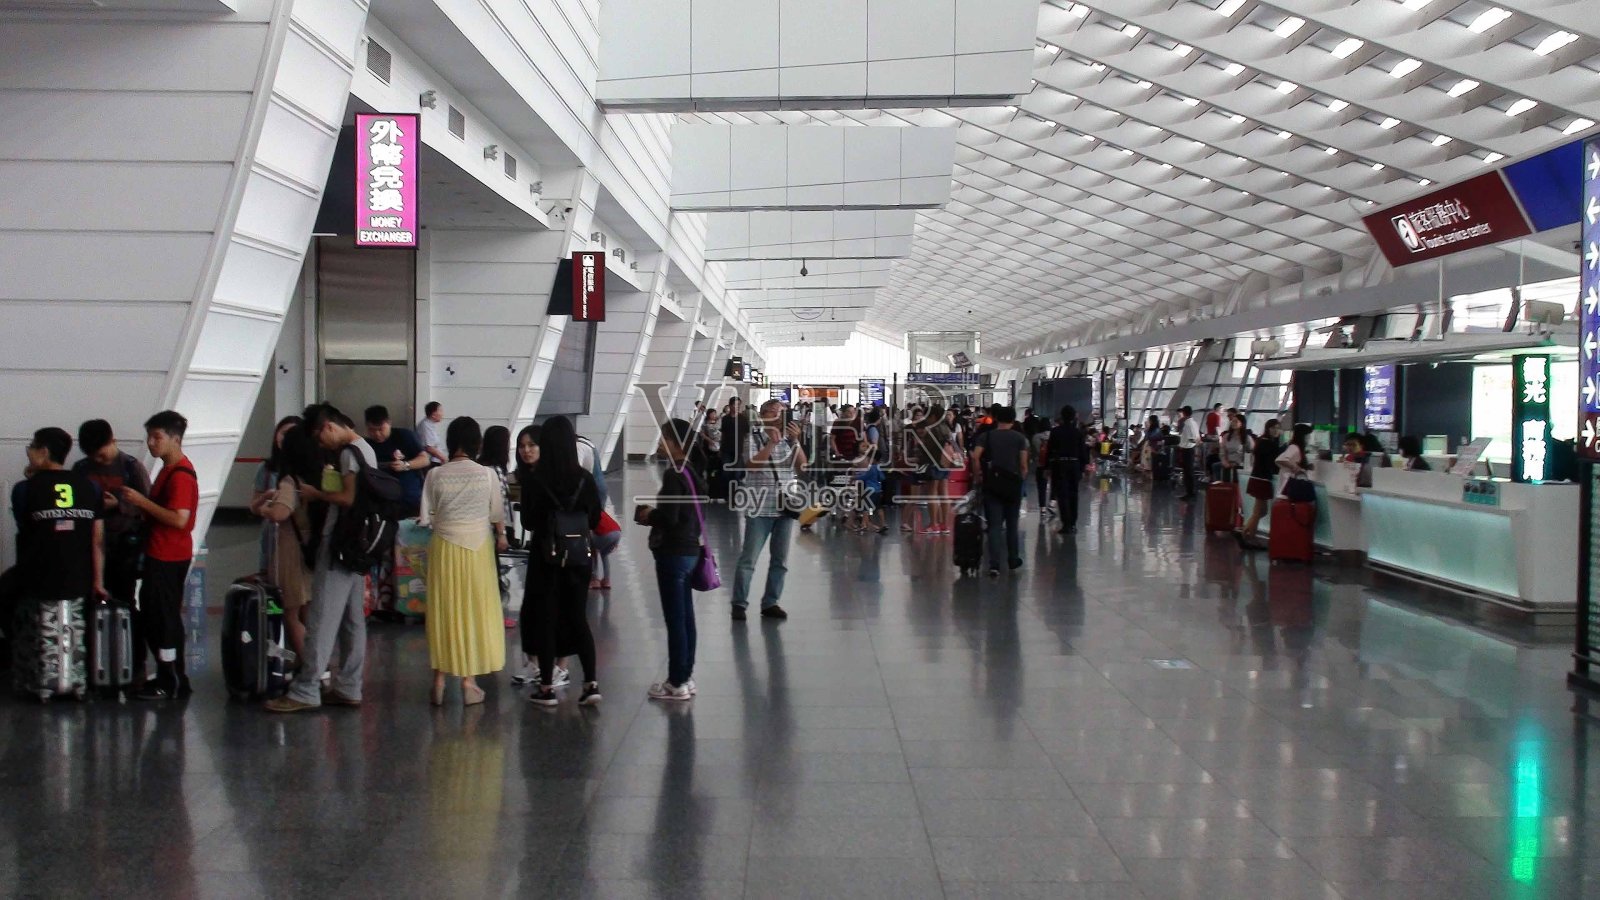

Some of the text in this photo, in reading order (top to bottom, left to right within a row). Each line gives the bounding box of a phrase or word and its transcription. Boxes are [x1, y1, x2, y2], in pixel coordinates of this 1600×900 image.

[370, 215, 402, 228] MONEY
[359, 230, 413, 242] EXCHANGER
[1420, 222, 1493, 249] Tourist service center
[54, 483, 74, 508] 3
